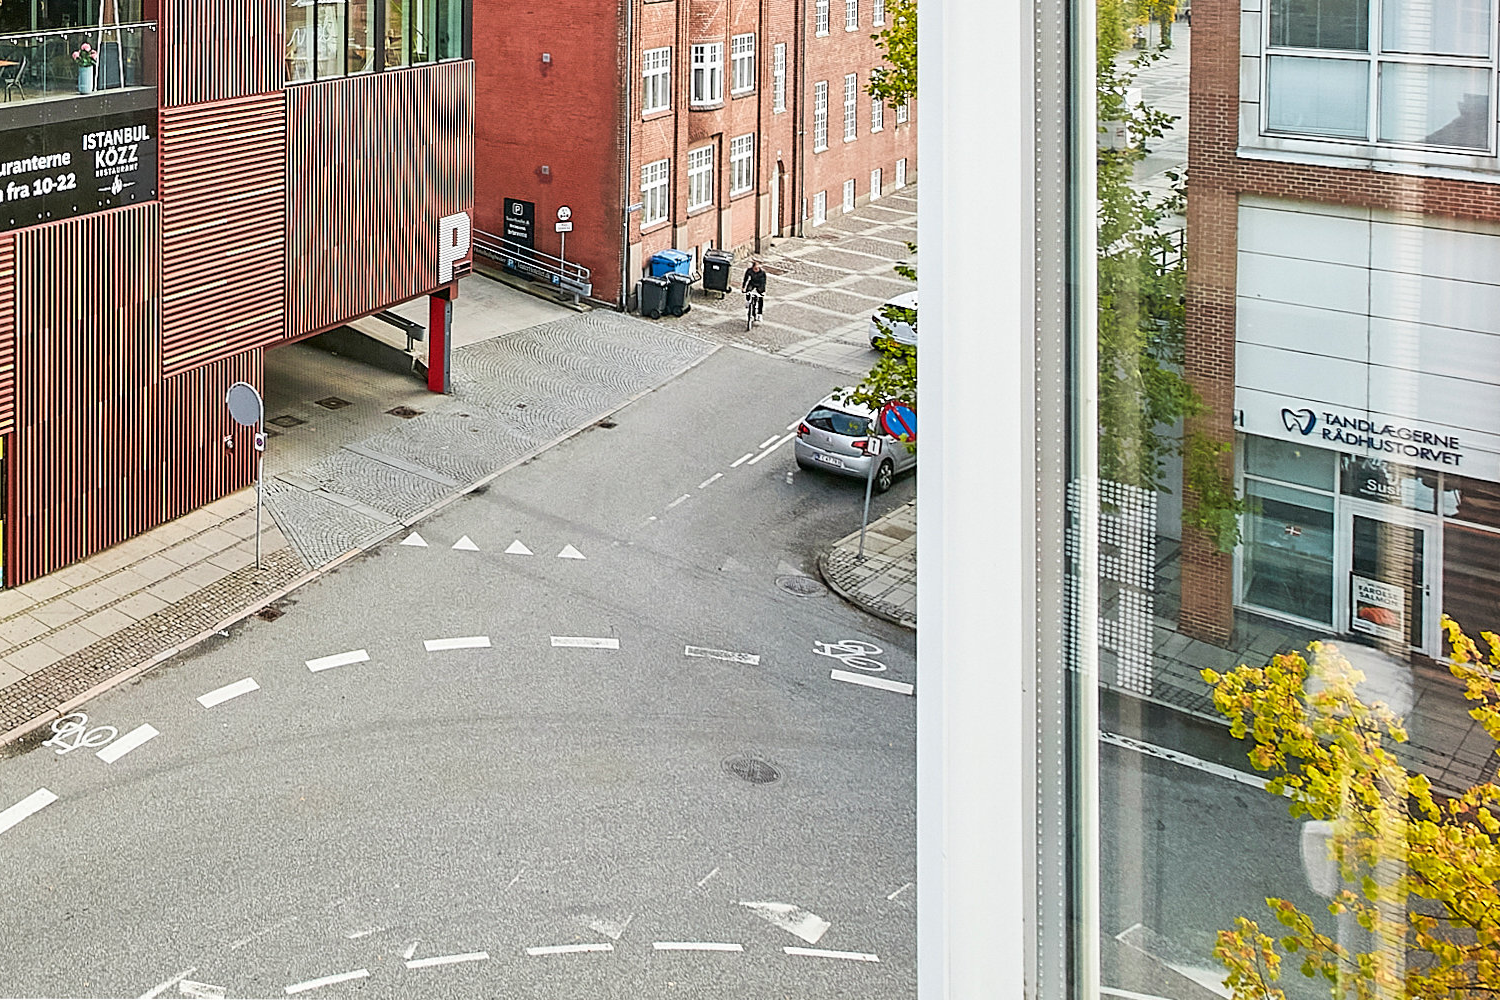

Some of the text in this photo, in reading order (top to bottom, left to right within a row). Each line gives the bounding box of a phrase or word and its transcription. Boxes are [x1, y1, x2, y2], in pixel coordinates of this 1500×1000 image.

[83, 125, 150, 150] ISTANBUL
[95, 144, 138, 169] KÖZZ
[6, 182, 31, 201] fra
[33, 173, 77, 196] 10-22
[438, 210, 471, 285] P
[1322, 412, 1460, 449] TANDLÆGERNE
[1322, 428, 1463, 466] RÅDHUSTORVET
